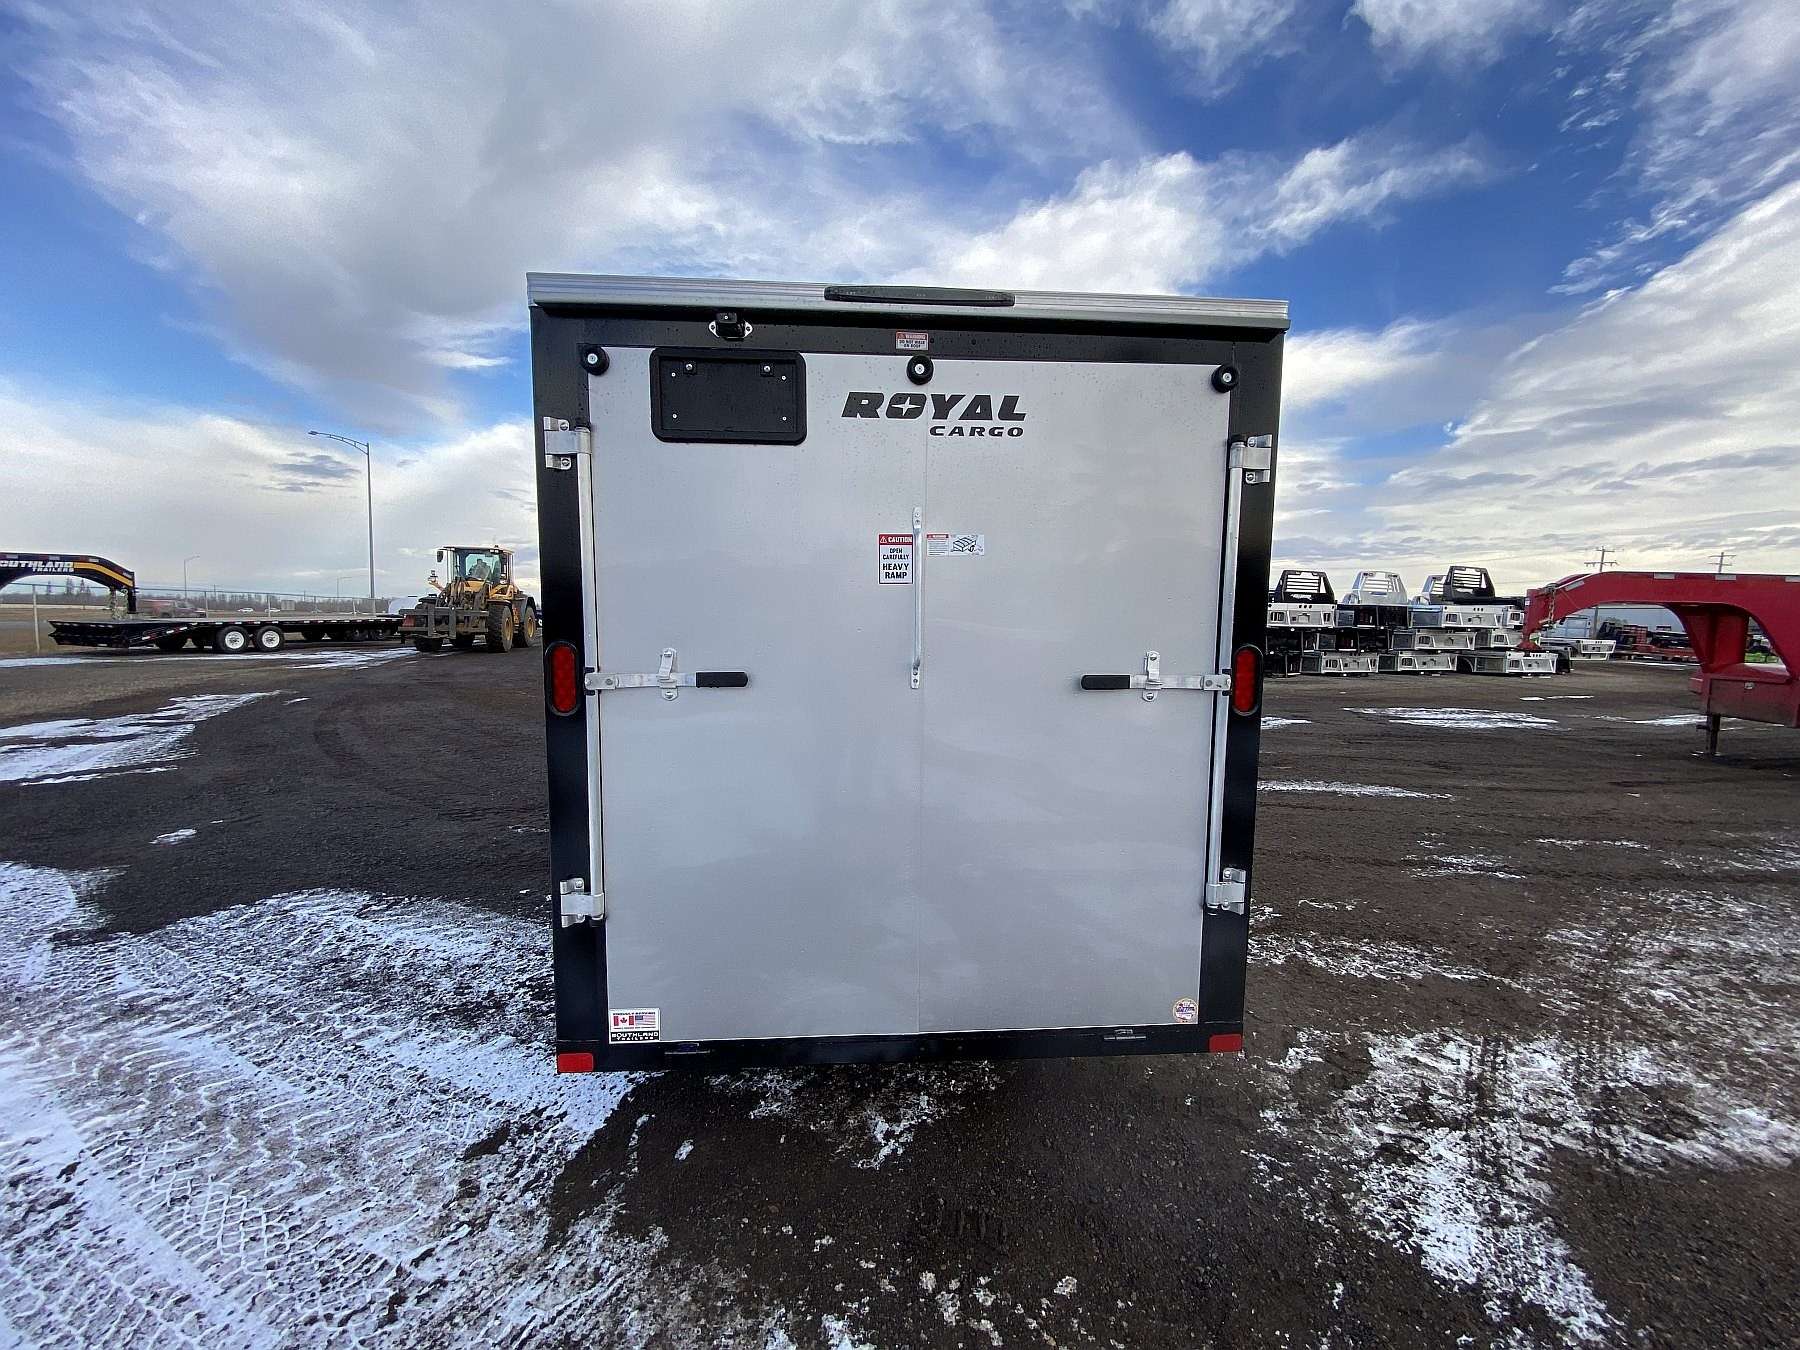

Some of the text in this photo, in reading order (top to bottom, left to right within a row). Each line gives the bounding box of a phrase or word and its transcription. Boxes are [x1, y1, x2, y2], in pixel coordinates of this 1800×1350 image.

[841, 391, 1026, 421] ROYAL
[929, 425, 1024, 437] CARGO
[882, 563, 909, 571] HEAVY
[884, 571, 907, 579] RAMP
